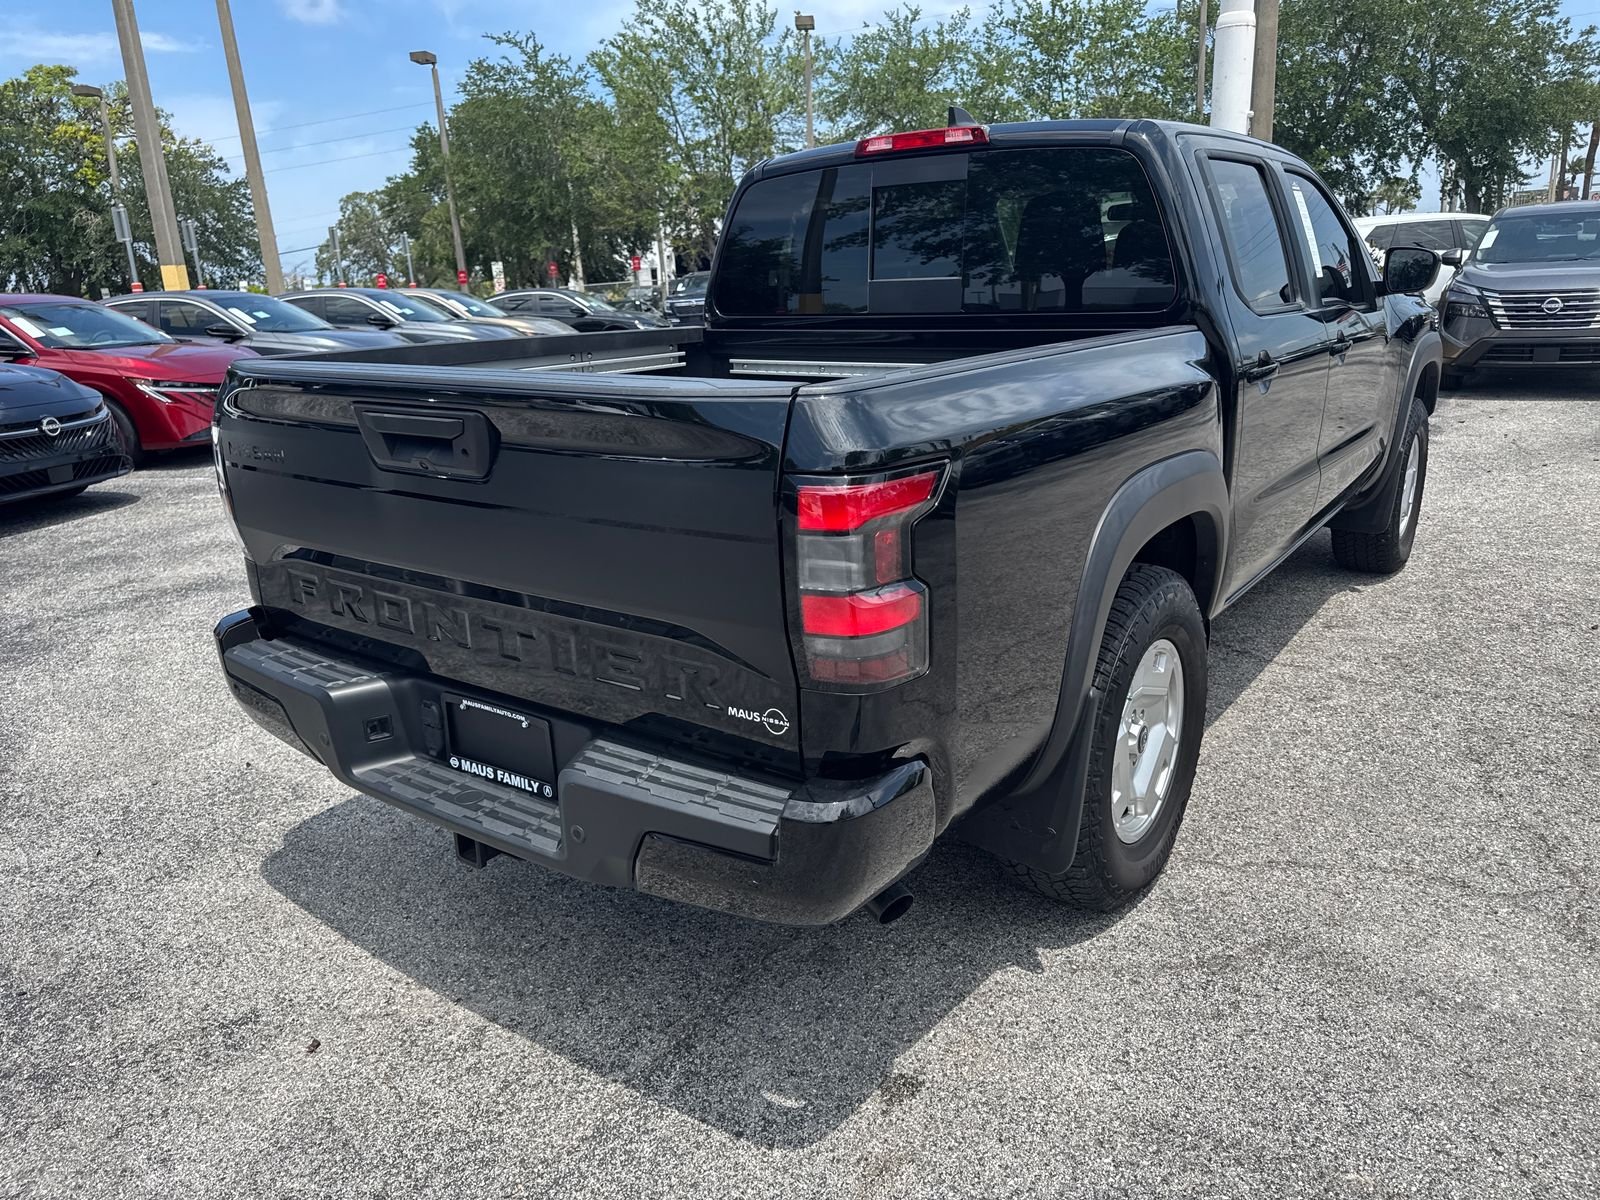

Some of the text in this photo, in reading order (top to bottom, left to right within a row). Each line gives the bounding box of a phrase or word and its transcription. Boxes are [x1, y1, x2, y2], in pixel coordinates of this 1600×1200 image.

[287, 568, 724, 711] FRONTIER
[462, 699, 527, 722] MAUSFAMILYAUTO.COM
[727, 706, 790, 727] MAUS NISSAN
[460, 759, 495, 779] MAUS
[496, 769, 540, 793] FAMILY
